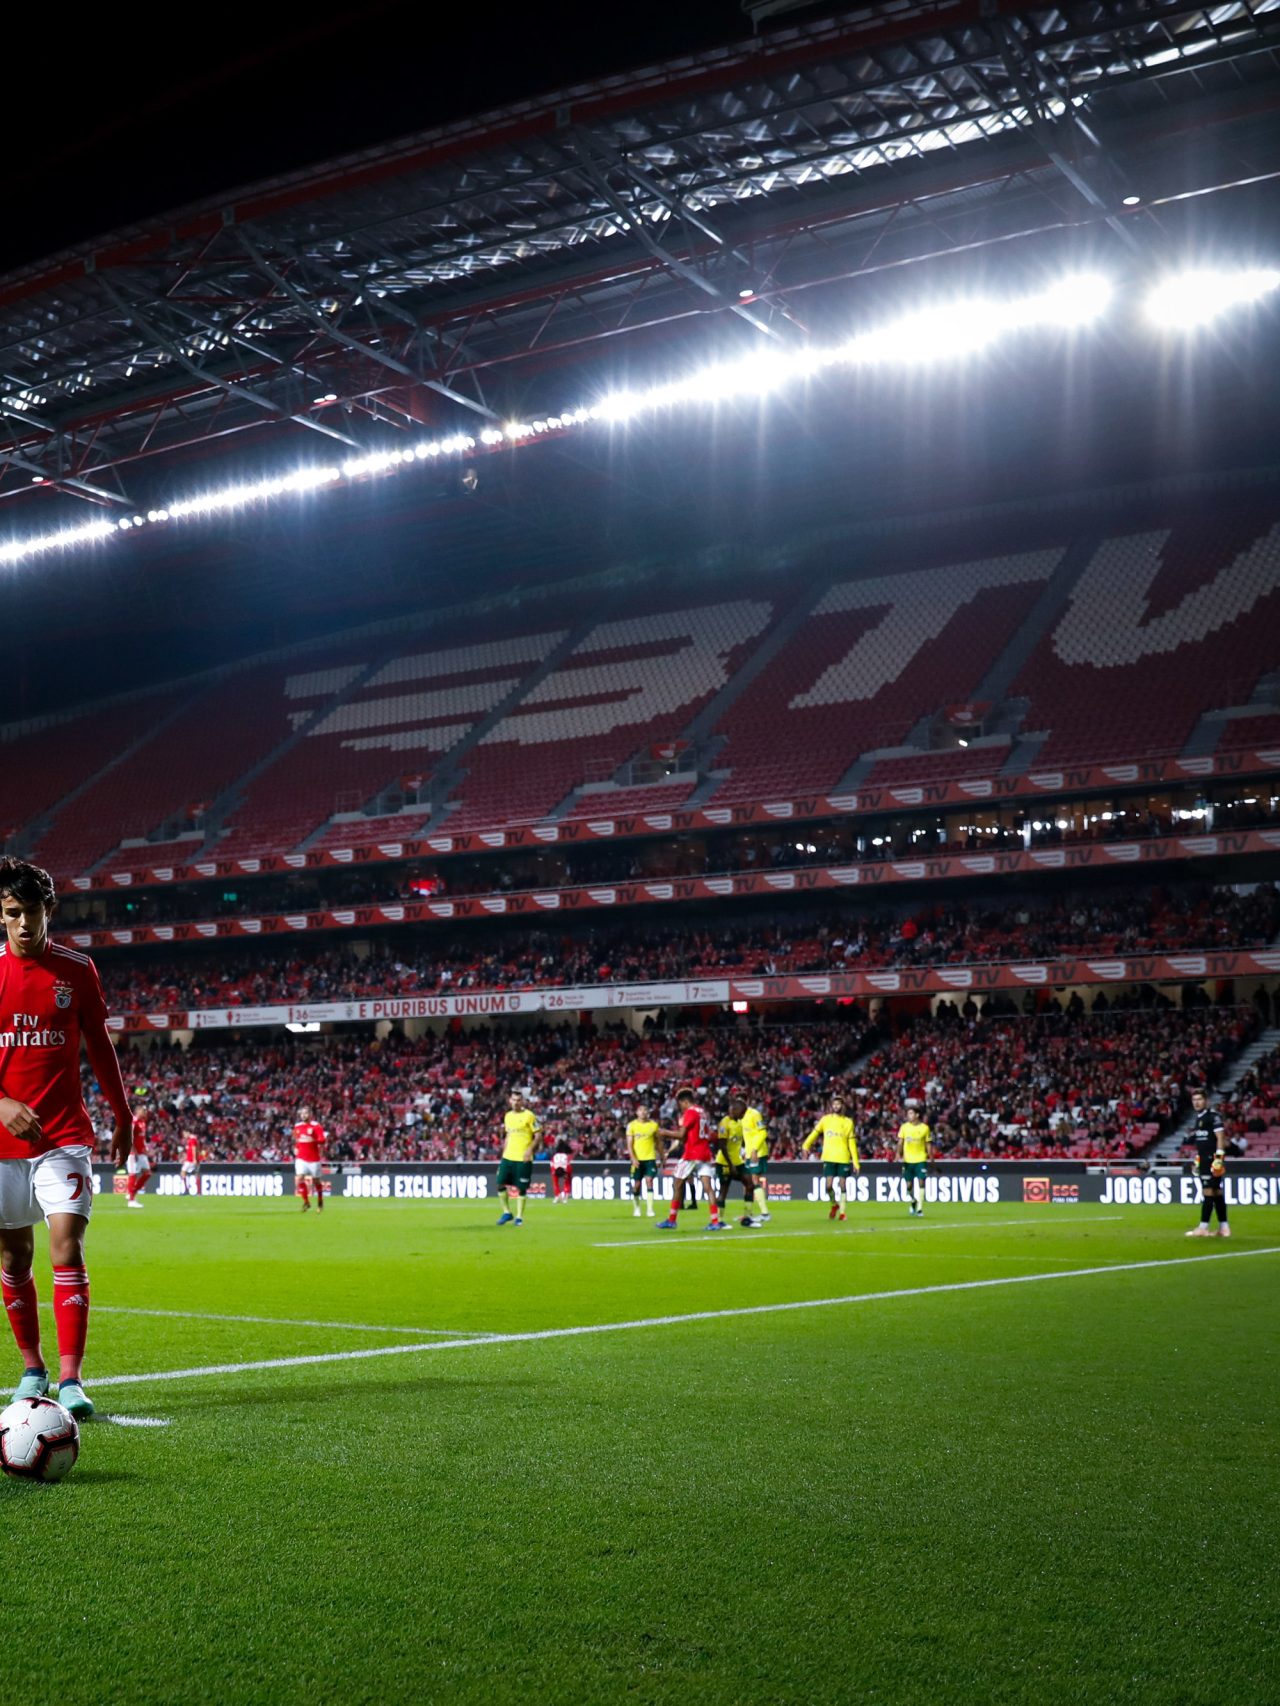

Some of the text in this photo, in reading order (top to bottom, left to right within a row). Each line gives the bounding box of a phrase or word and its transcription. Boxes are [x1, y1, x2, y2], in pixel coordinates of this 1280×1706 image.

[618, 992, 624, 1003] 7
[693, 988, 699, 998] 7
[360, 996, 505, 1018] E PLURIBUS UNUM
[549, 997, 563, 1006] 26
[13, 1013, 39, 1028] Fly
[296, 1010, 308, 1020] 36
[201, 1175, 283, 1196] EXCLUSIVOS
[343, 1175, 487, 1198] JOGOS EXCLUSIVOS
[571, 1176, 615, 1200] OGOS
[1052, 1185, 1079, 1196] ESC
[1100, 1177, 1172, 1204] JOGOS
